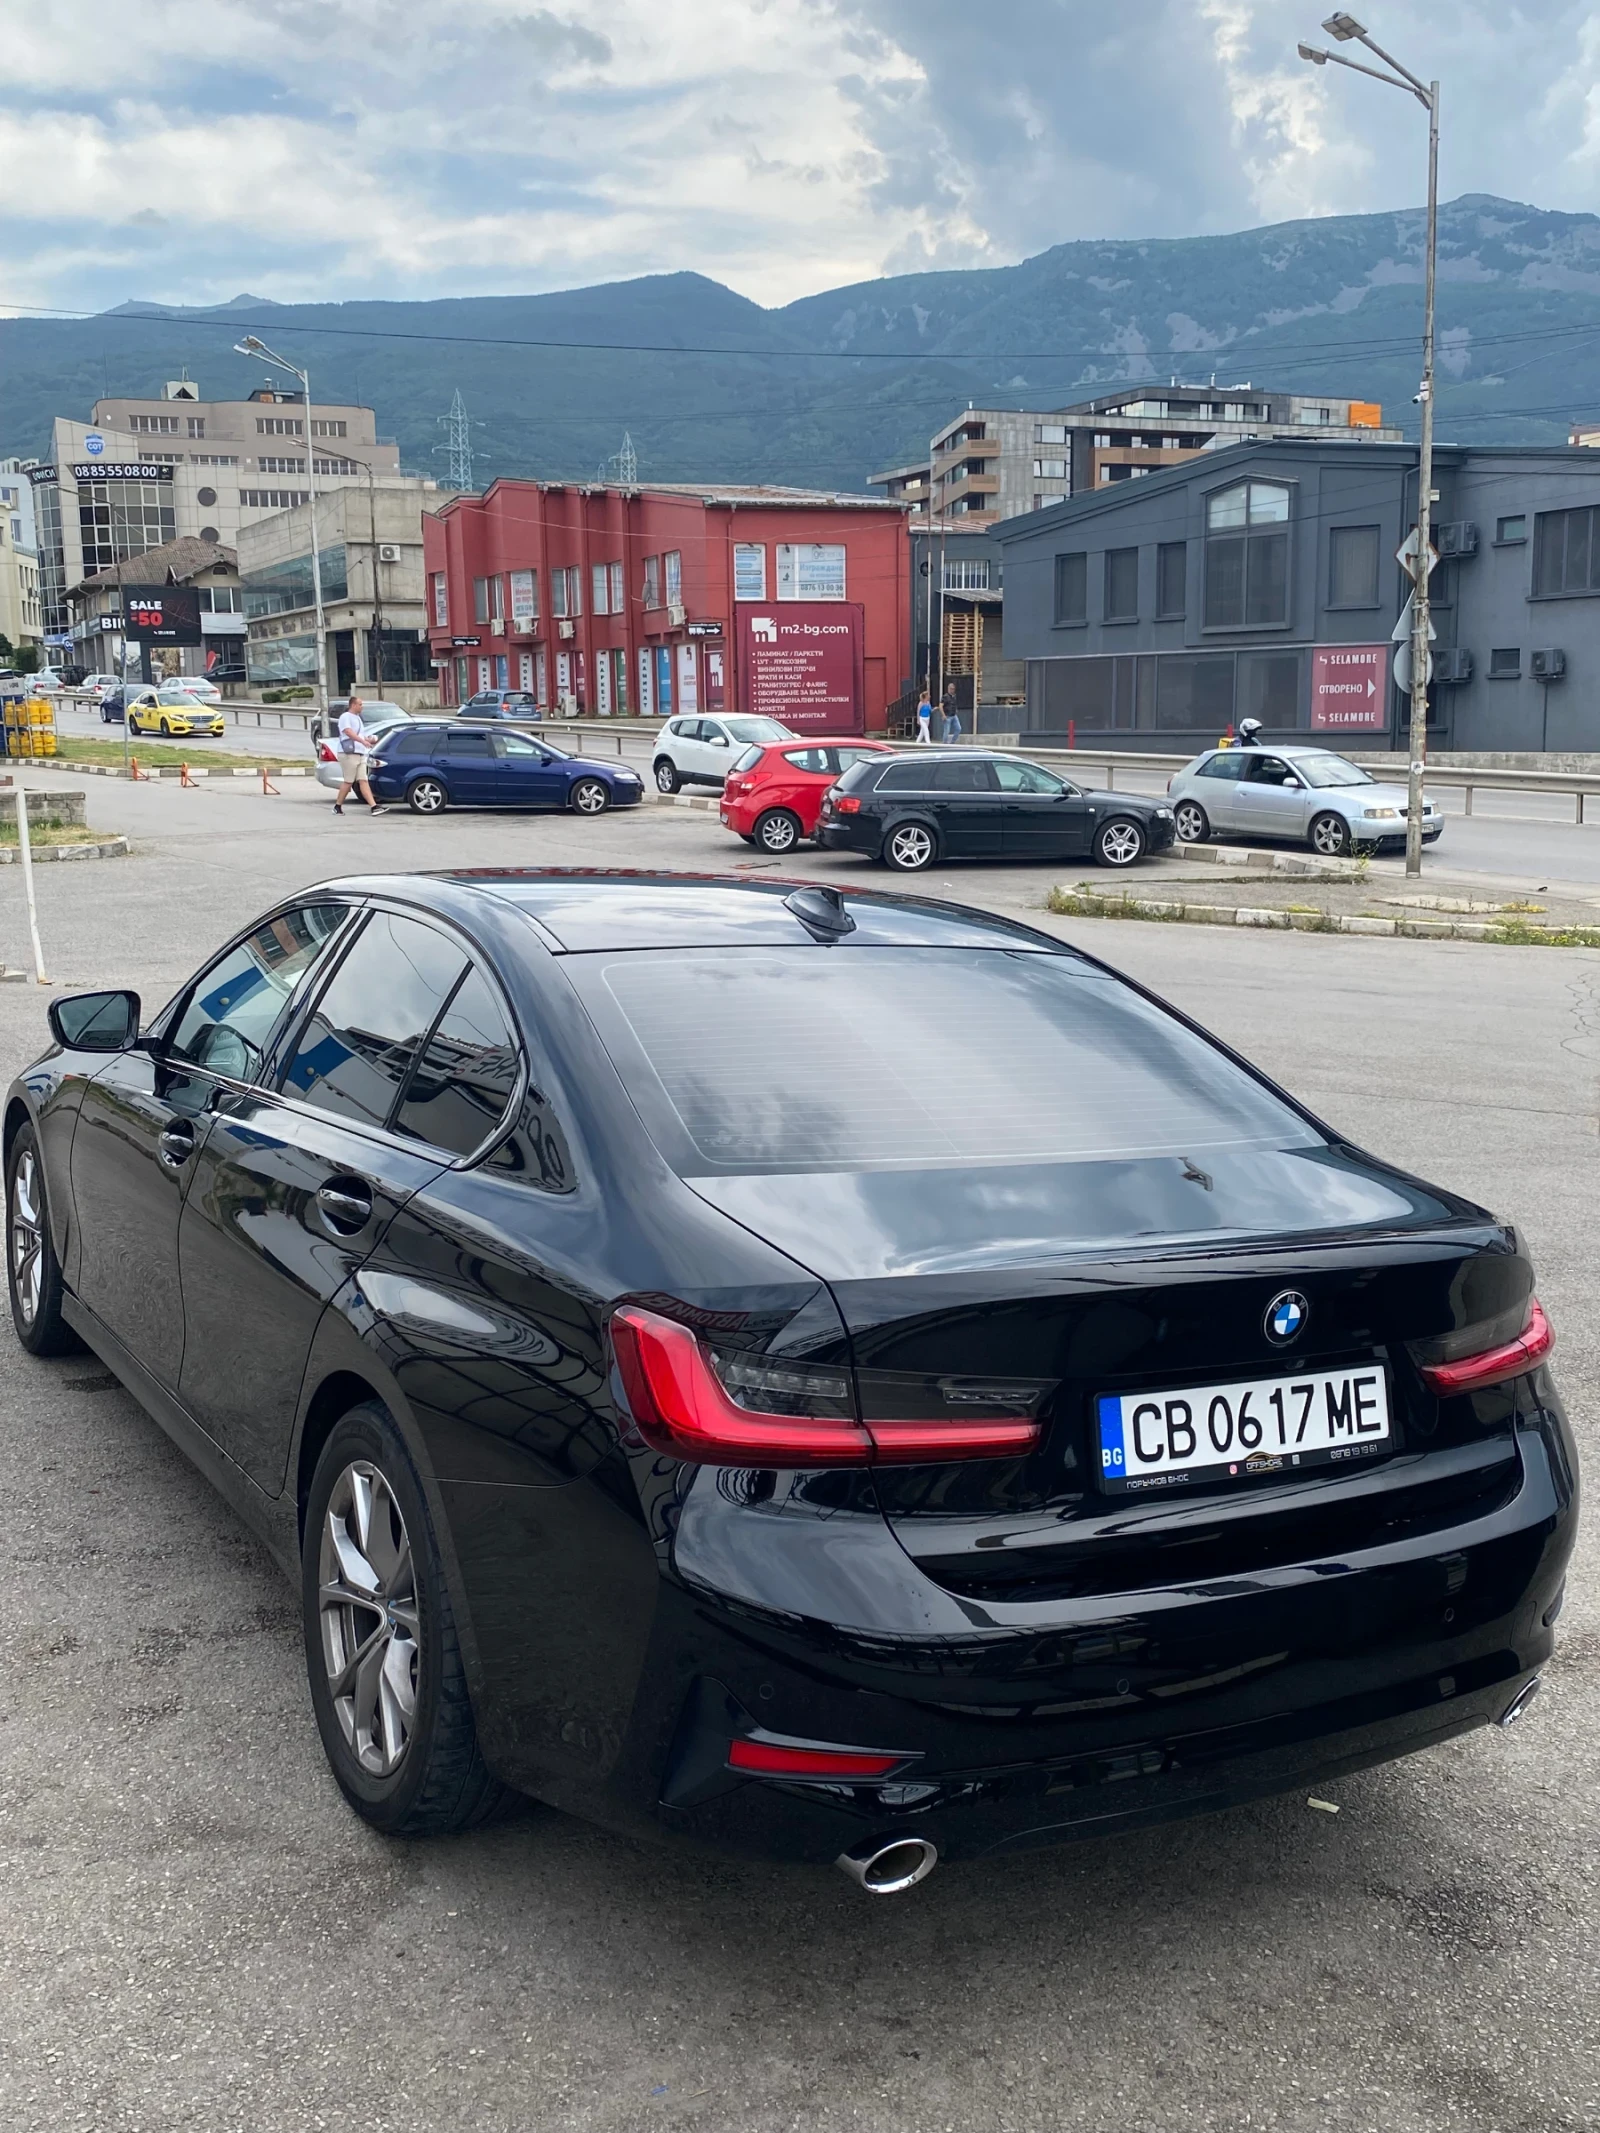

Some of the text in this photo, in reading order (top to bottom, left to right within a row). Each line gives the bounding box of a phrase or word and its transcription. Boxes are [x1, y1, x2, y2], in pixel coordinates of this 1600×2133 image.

[130, 600, 162, 610] SALE
[781, 624, 849, 636] m2-bg.com
[1330, 653, 1378, 665] SELAMORE
[1319, 683, 1363, 694] ОТВОРЕНО
[1329, 712, 1376, 723] SELAMORE
[1272, 1294, 1307, 1312] BMW
[1132, 1375, 1382, 1463] CB 0617 ME
[1102, 1448, 1123, 1468] BG
[1246, 1458, 1283, 1470] OFFSHORE
